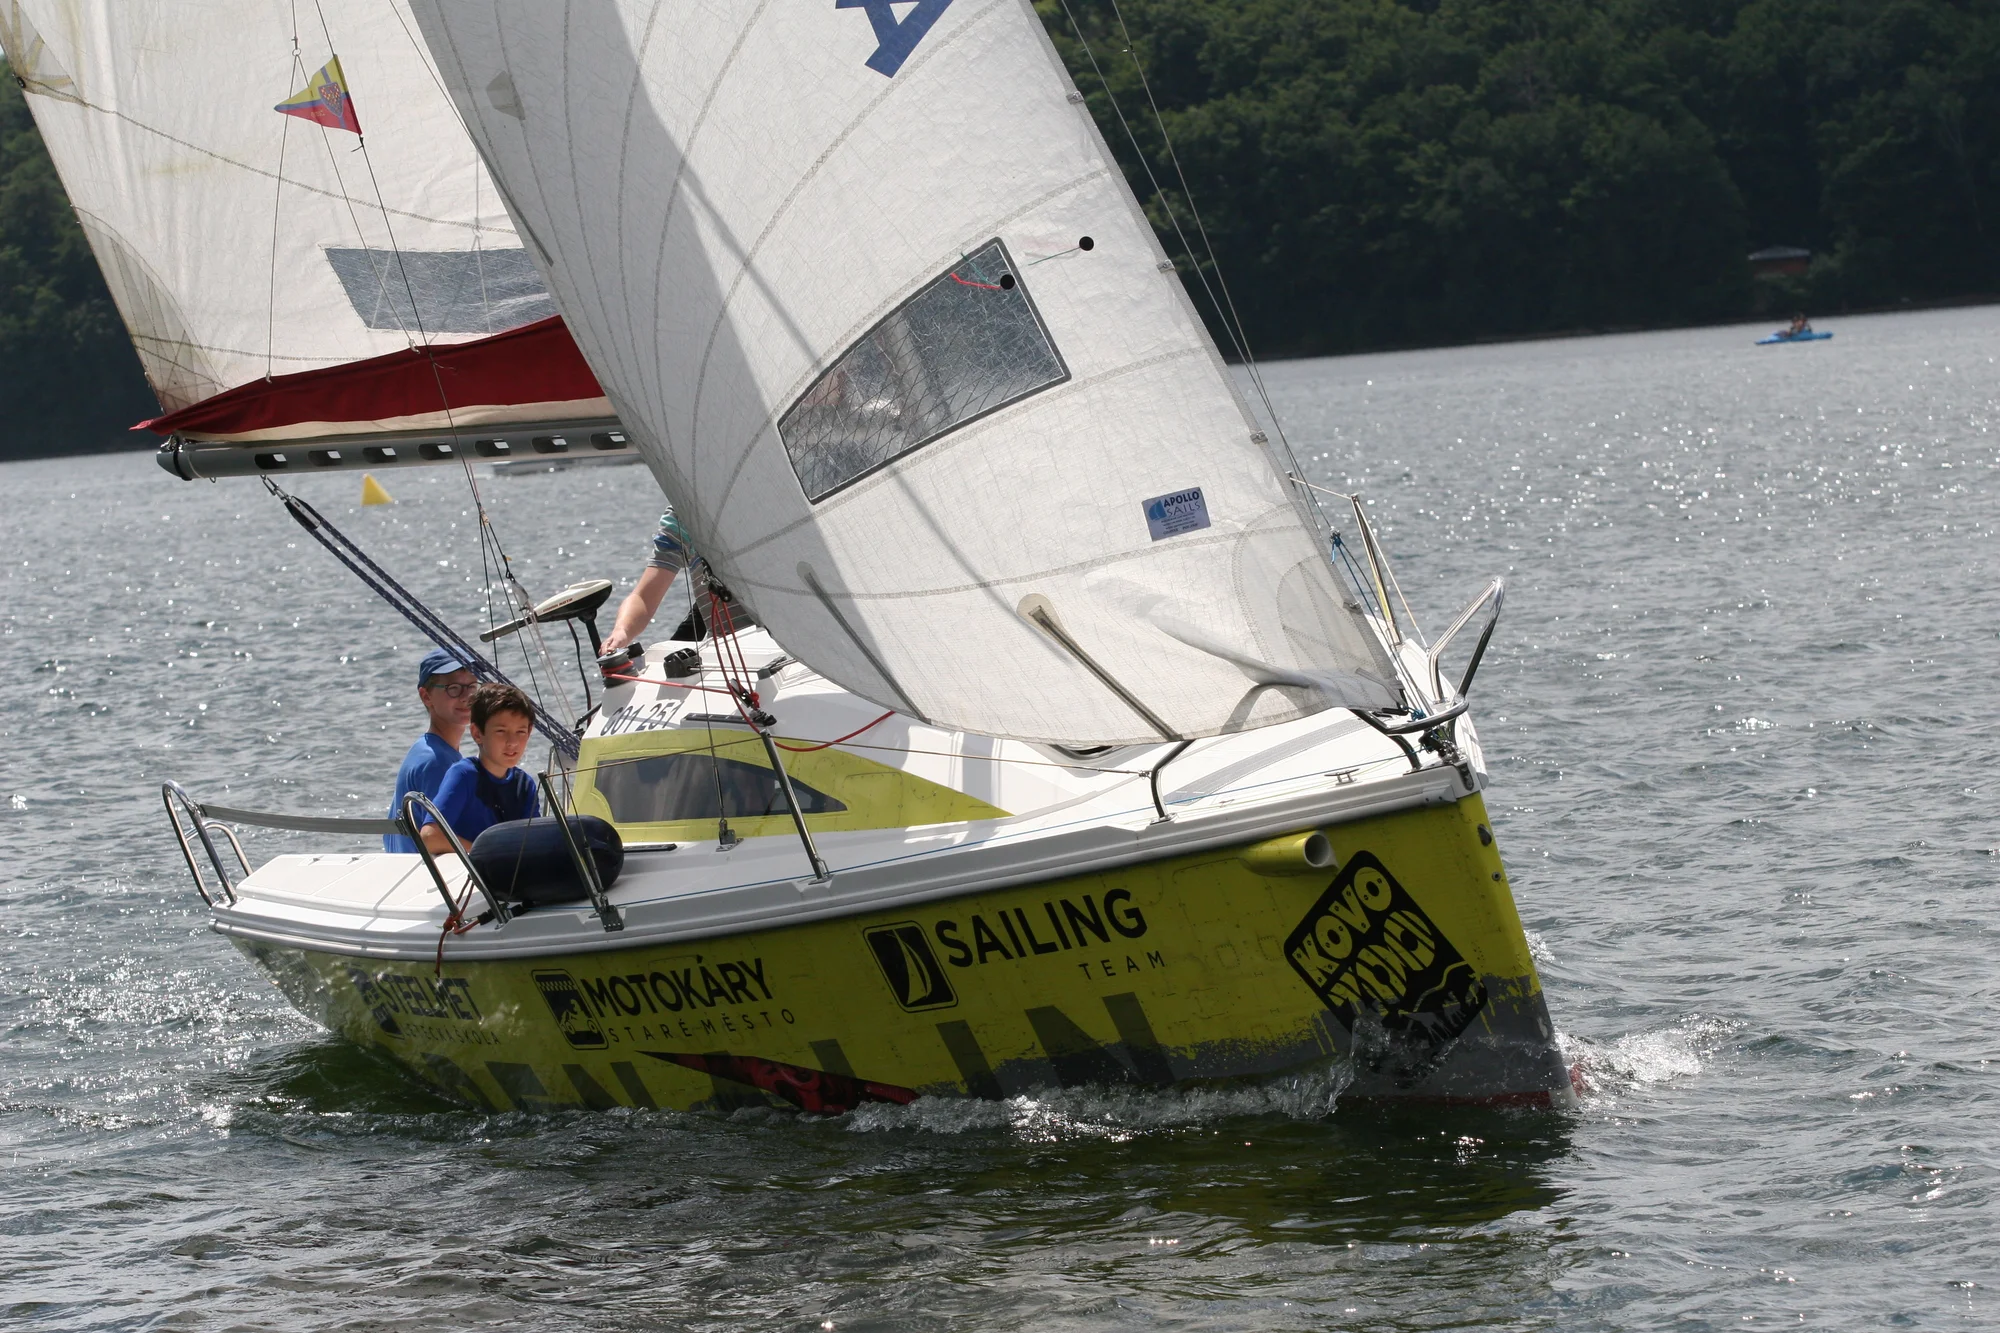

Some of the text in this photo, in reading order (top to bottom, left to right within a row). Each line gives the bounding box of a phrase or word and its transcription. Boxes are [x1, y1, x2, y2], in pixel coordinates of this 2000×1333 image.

[1163, 491, 1200, 508] APOLLO
[1167, 501, 1201, 518] SAILS
[635, 699, 685, 732] 251
[934, 888, 1148, 968] SAILING
[1291, 866, 1392, 988] KOVO
[1078, 950, 1165, 981] TEAM
[580, 954, 773, 1018] MOTOKÁRY
[608, 1008, 795, 1043] STARÉ MĚSTO
